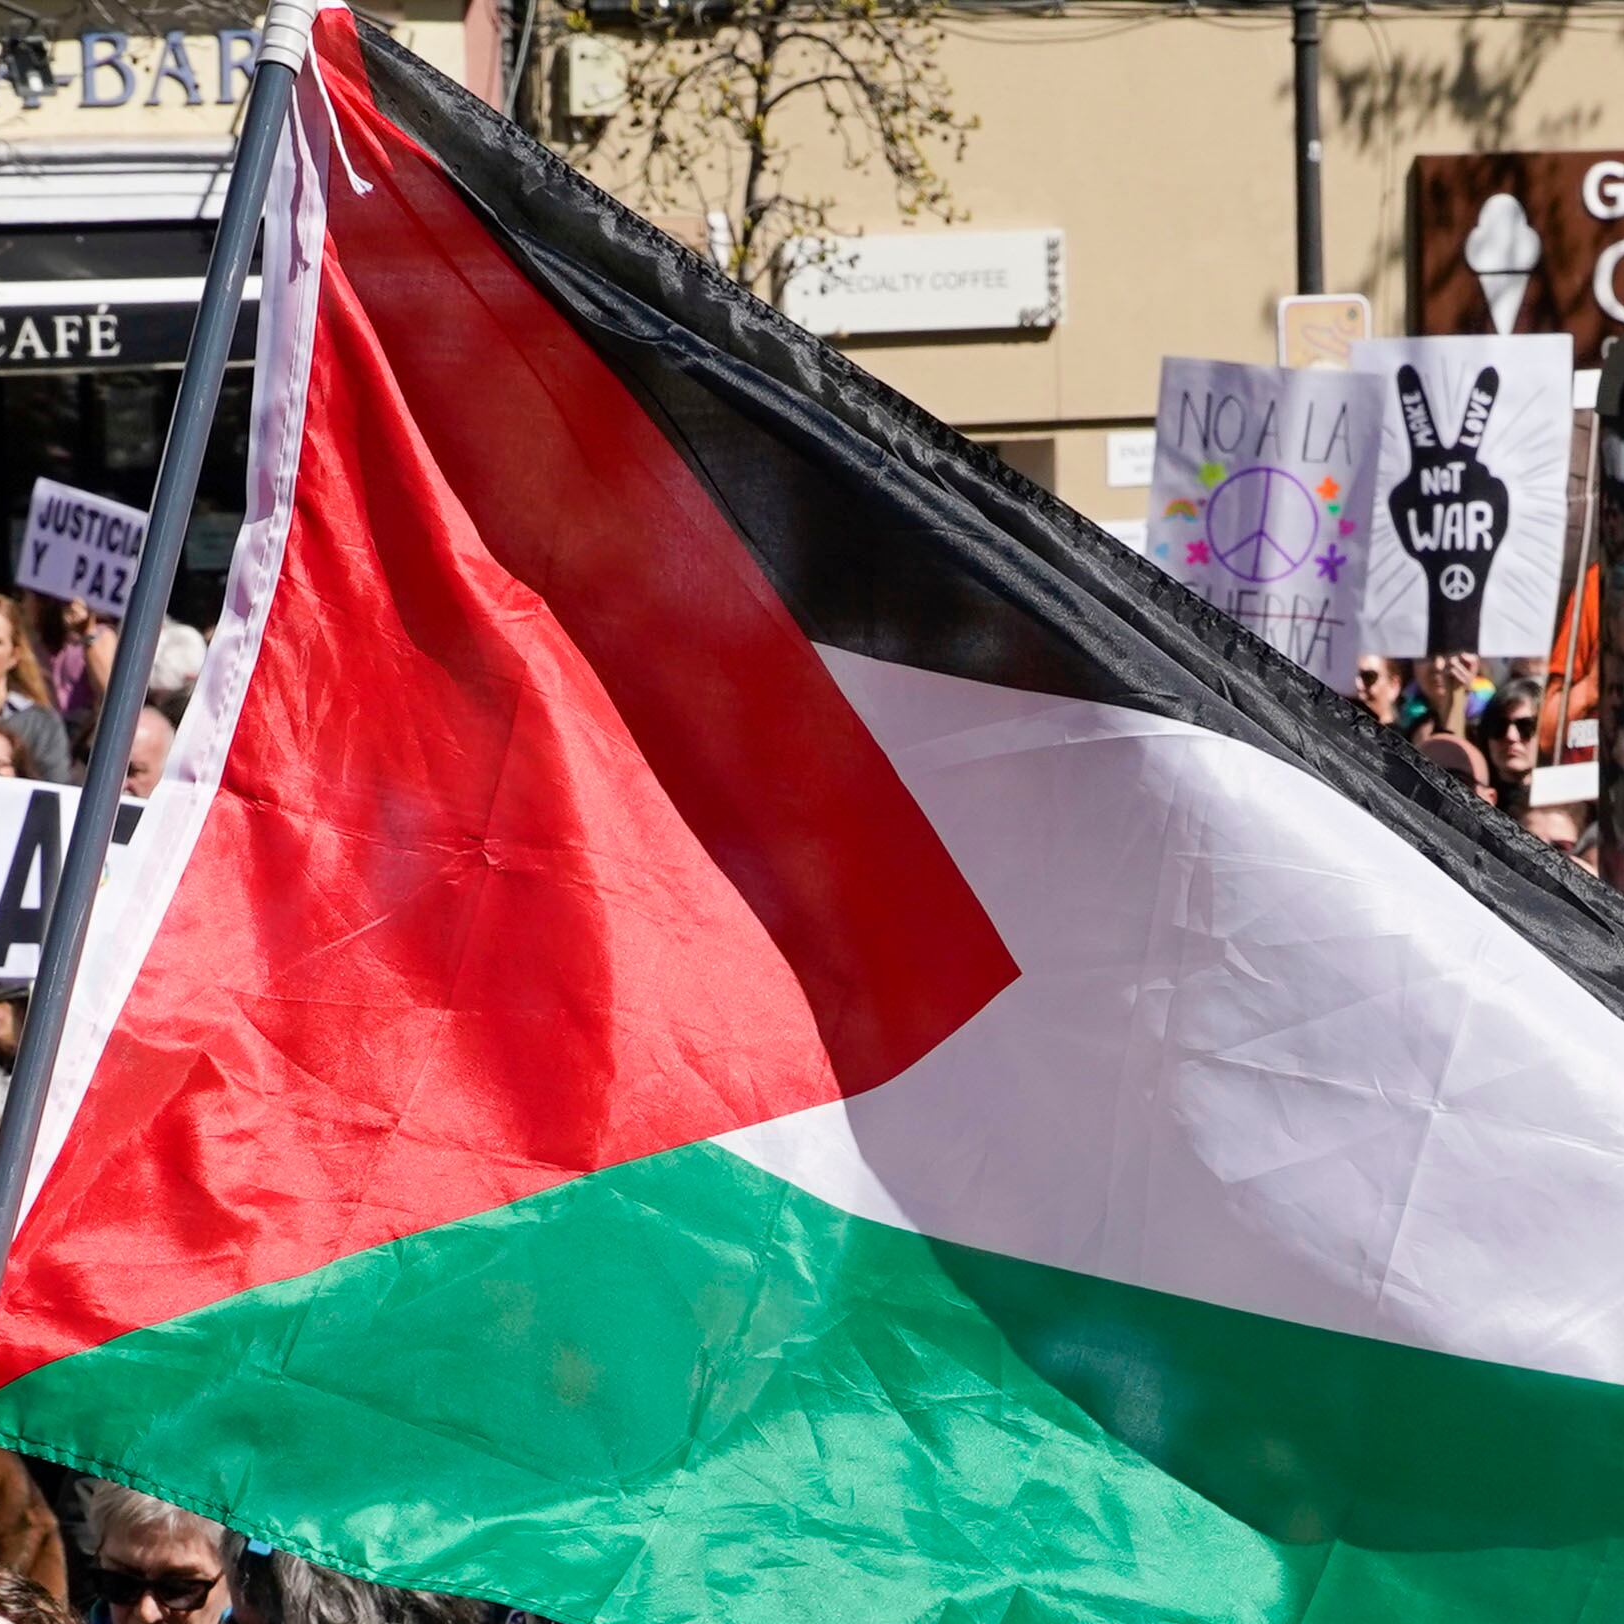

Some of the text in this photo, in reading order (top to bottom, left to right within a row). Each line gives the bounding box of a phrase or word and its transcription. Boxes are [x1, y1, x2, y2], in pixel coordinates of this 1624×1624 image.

[930, 268, 1009, 291] COFFEE
[1177, 392, 1246, 453] NO
[1301, 401, 1352, 465] LA
[1402, 388, 1437, 448] MAKE
[1459, 387, 1494, 448] LOVE
[1420, 461, 1467, 496] NOT
[38, 496, 143, 557] JUSTICIA
[1407, 500, 1494, 552] WAR
[32, 539, 128, 606] Y PAZ
